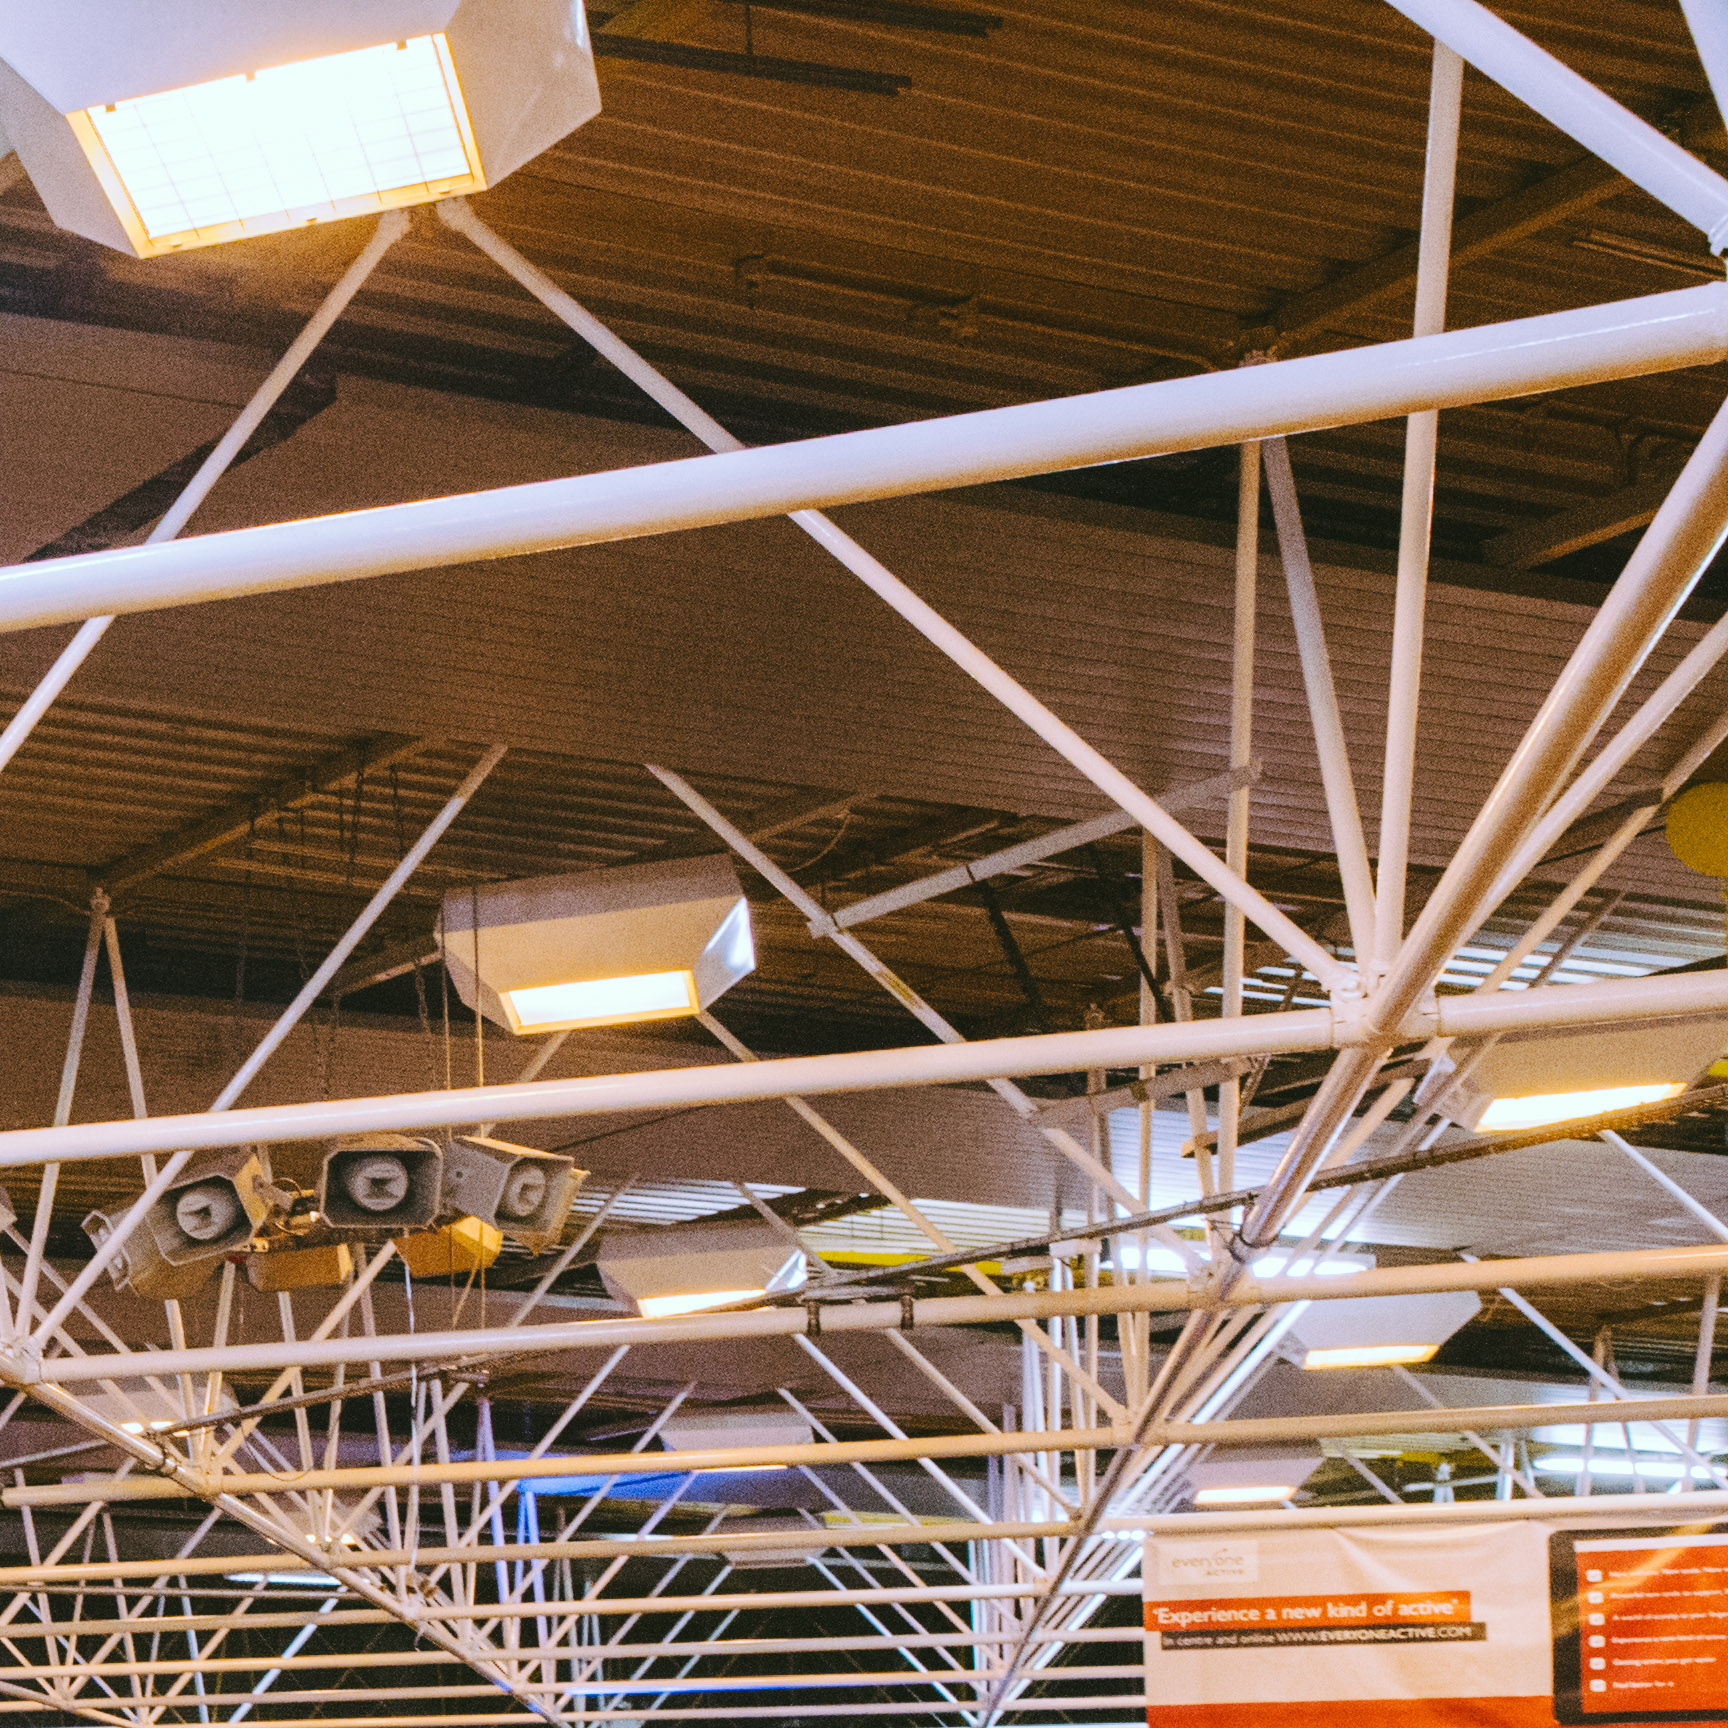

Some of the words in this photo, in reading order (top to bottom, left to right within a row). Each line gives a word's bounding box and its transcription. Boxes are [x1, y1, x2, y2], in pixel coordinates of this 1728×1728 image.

[1152, 1607, 1260, 1628] ‘Experience
[1265, 1608, 1277, 1621] a
[1282, 1606, 1323, 1619] new
[1327, 1601, 1367, 1618] kind
[1372, 1600, 1394, 1617] of
[1398, 1599, 1458, 1616] active’
